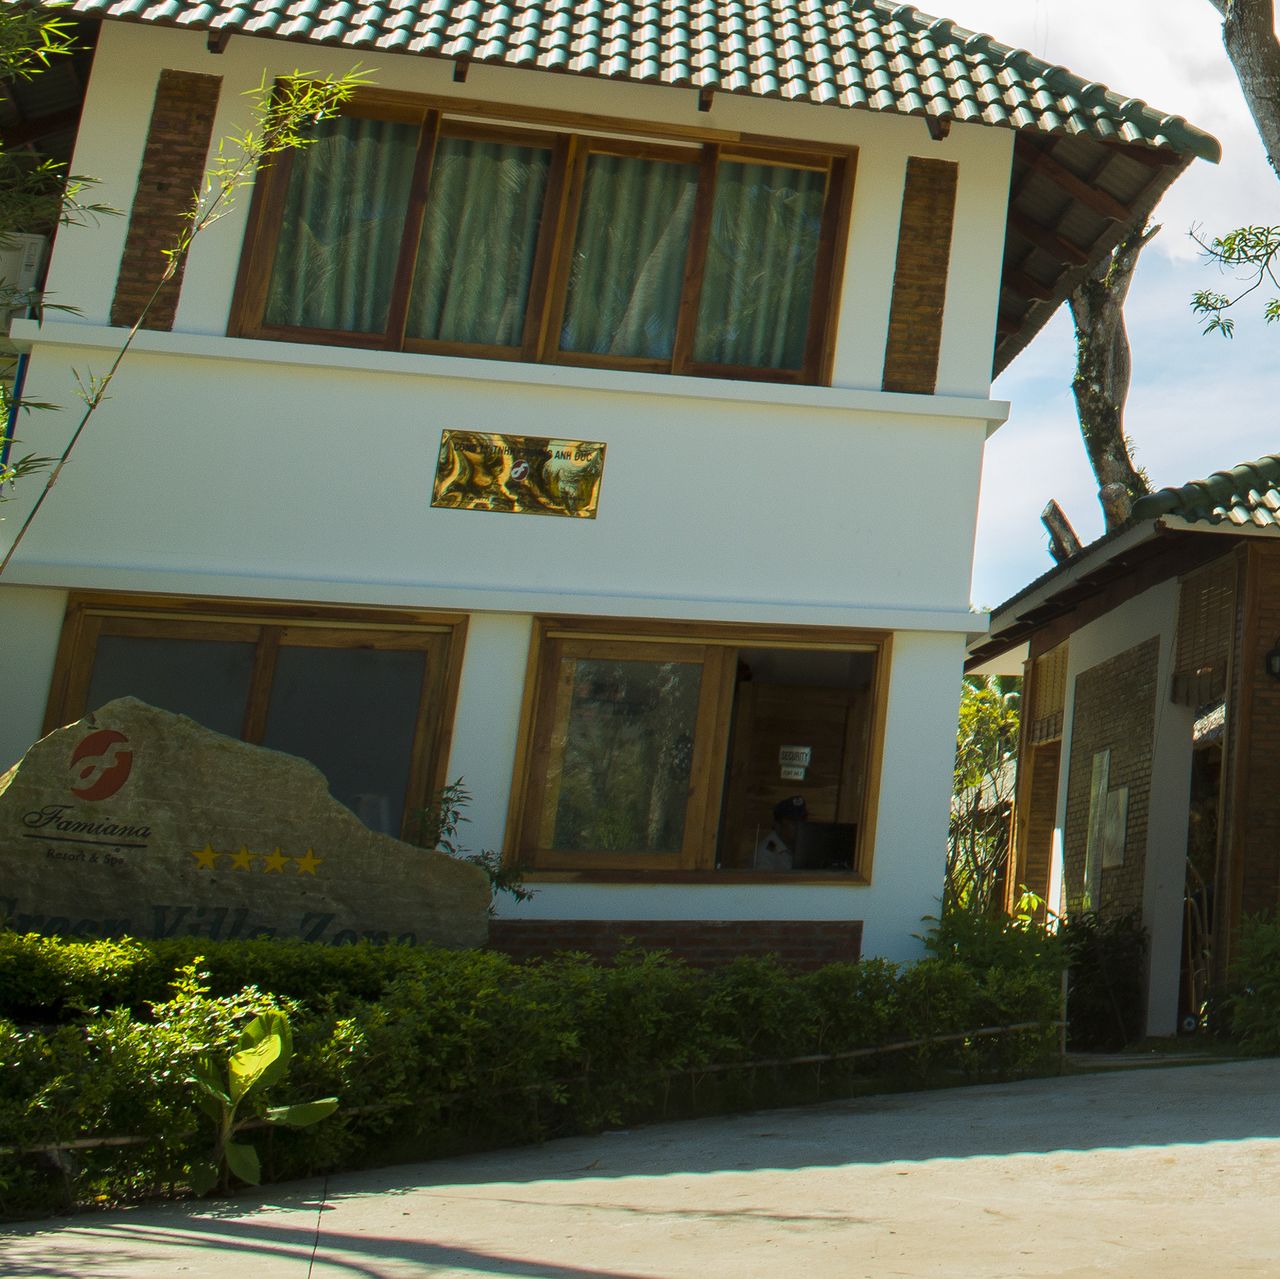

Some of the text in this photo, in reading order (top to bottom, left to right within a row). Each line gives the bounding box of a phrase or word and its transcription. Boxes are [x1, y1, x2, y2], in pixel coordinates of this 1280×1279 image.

[554, 450, 572, 461] ANH
[22, 804, 152, 838] Famiana
[46, 849, 126, 867] Resort & Spa
[148, 905, 277, 939] Villa
